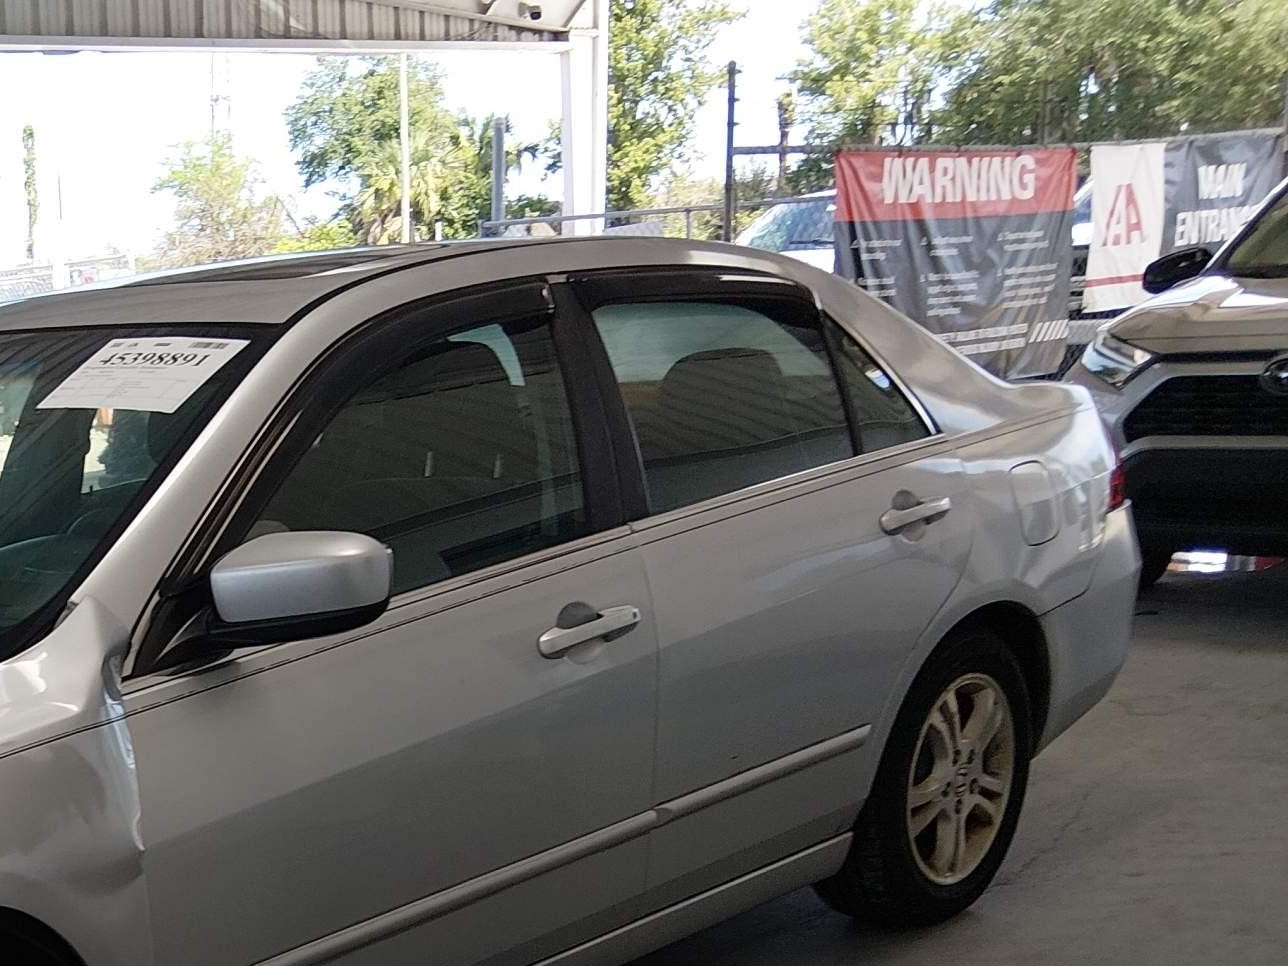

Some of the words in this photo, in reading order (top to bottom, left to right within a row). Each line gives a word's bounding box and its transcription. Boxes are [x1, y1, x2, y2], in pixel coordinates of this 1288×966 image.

[882, 155, 1036, 204] WARNING
[1198, 162, 1247, 200] MAIN
[100, 352, 211, 367] 45398891
